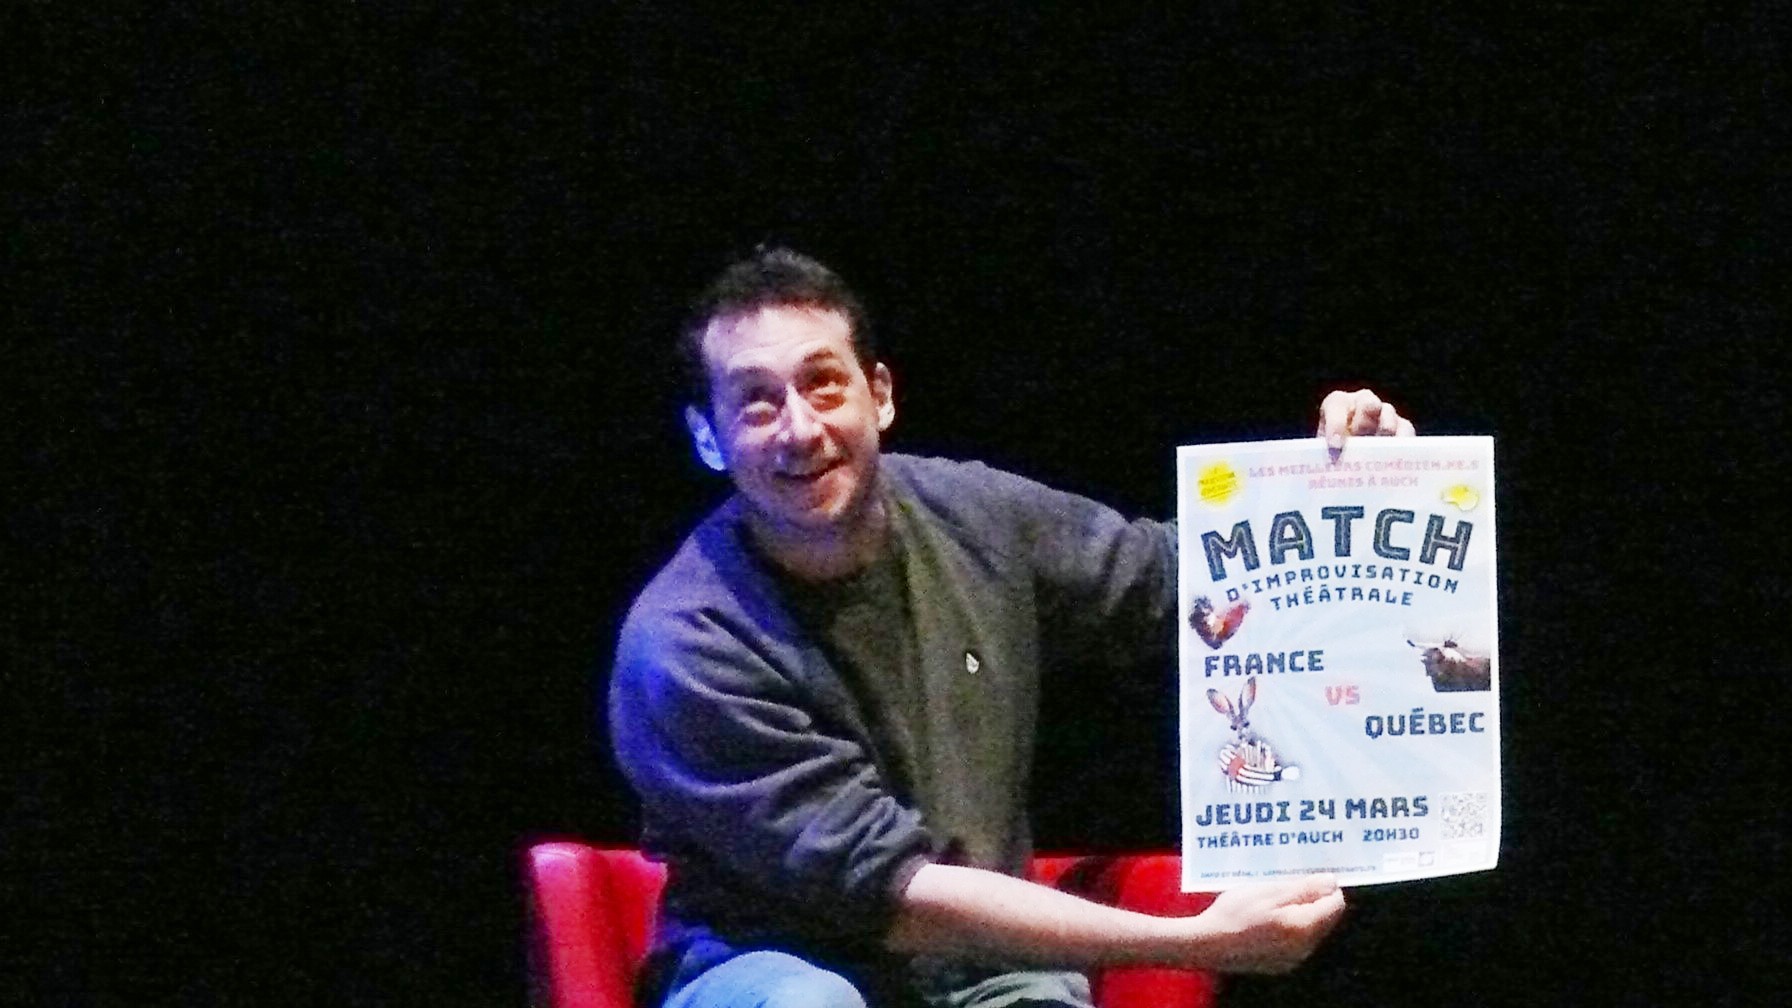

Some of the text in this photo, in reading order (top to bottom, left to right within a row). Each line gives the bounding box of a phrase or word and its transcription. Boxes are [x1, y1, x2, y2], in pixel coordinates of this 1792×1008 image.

[1201, 505, 1473, 582] MATCH
[1226, 564, 1459, 602] D'IMPROVISATION
[1271, 586, 1414, 611] THÉÂTRALE
[1205, 650, 1324, 677] FRANCE
[1325, 685, 1361, 706] VS
[1365, 707, 1485, 739] QUÉBEC
[1196, 796, 1429, 827] JEUDI 24 MARS
[1197, 827, 1420, 849] THÉÂTRE D'AUCH 20H30
